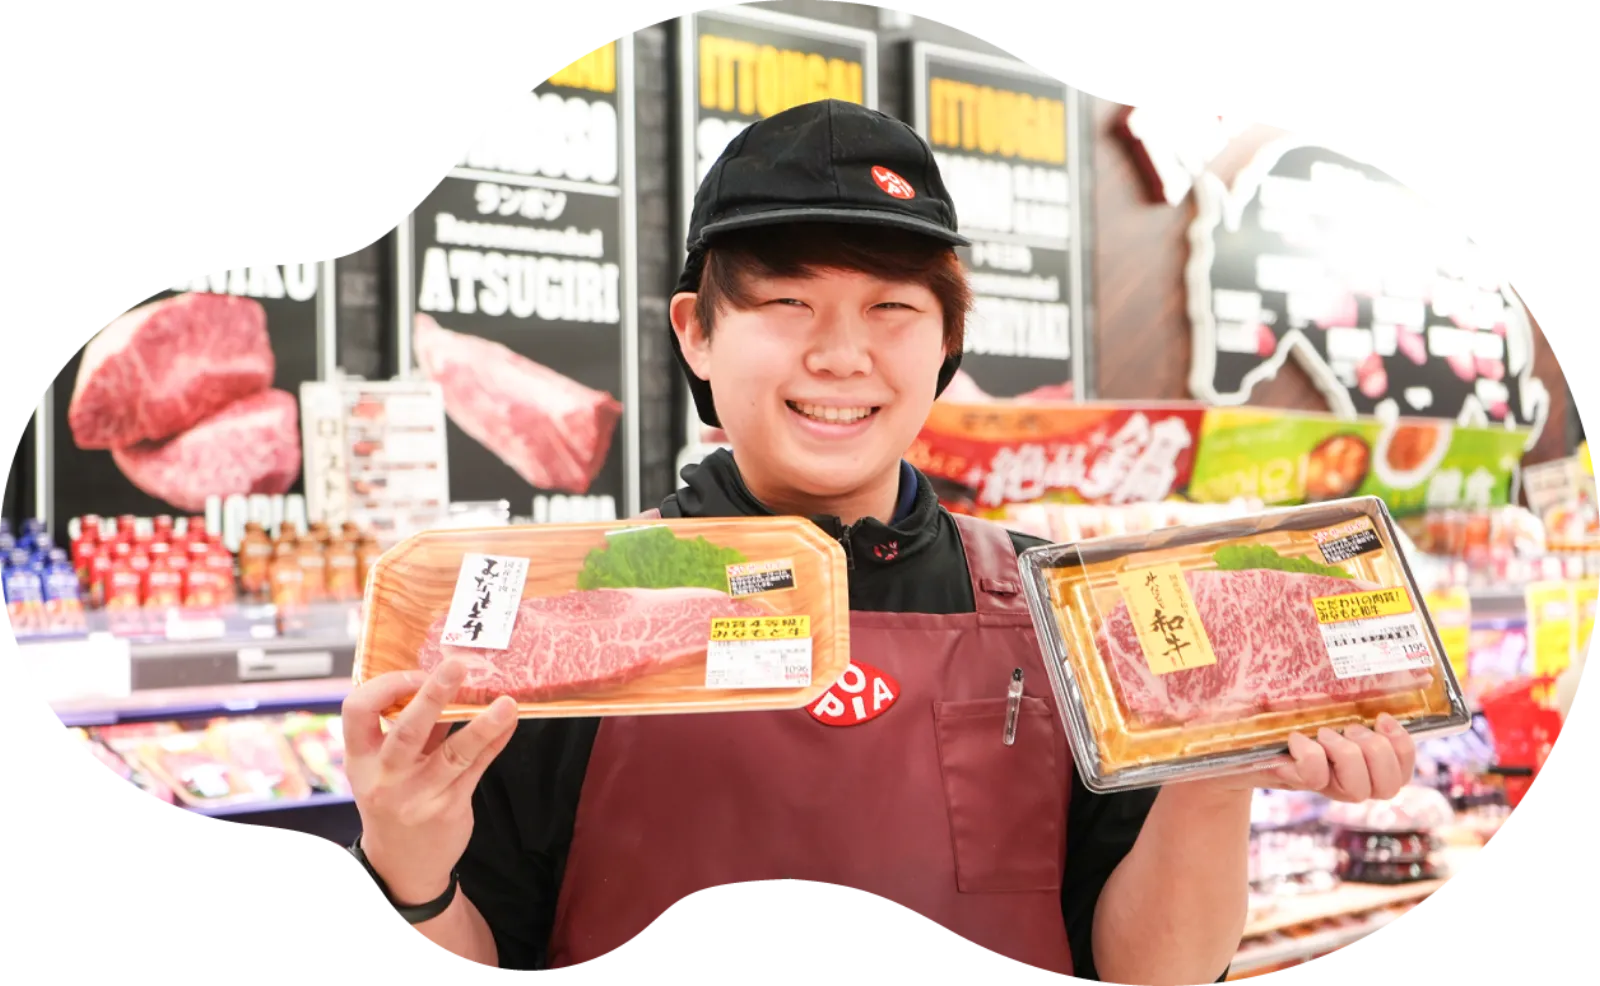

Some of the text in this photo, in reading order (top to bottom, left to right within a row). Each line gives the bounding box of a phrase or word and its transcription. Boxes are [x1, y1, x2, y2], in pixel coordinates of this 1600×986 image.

[418, 247, 620, 324] ATSUGIRI
[1402, 642, 1427, 653] 1195
[812, 663, 894, 721] OPIA
